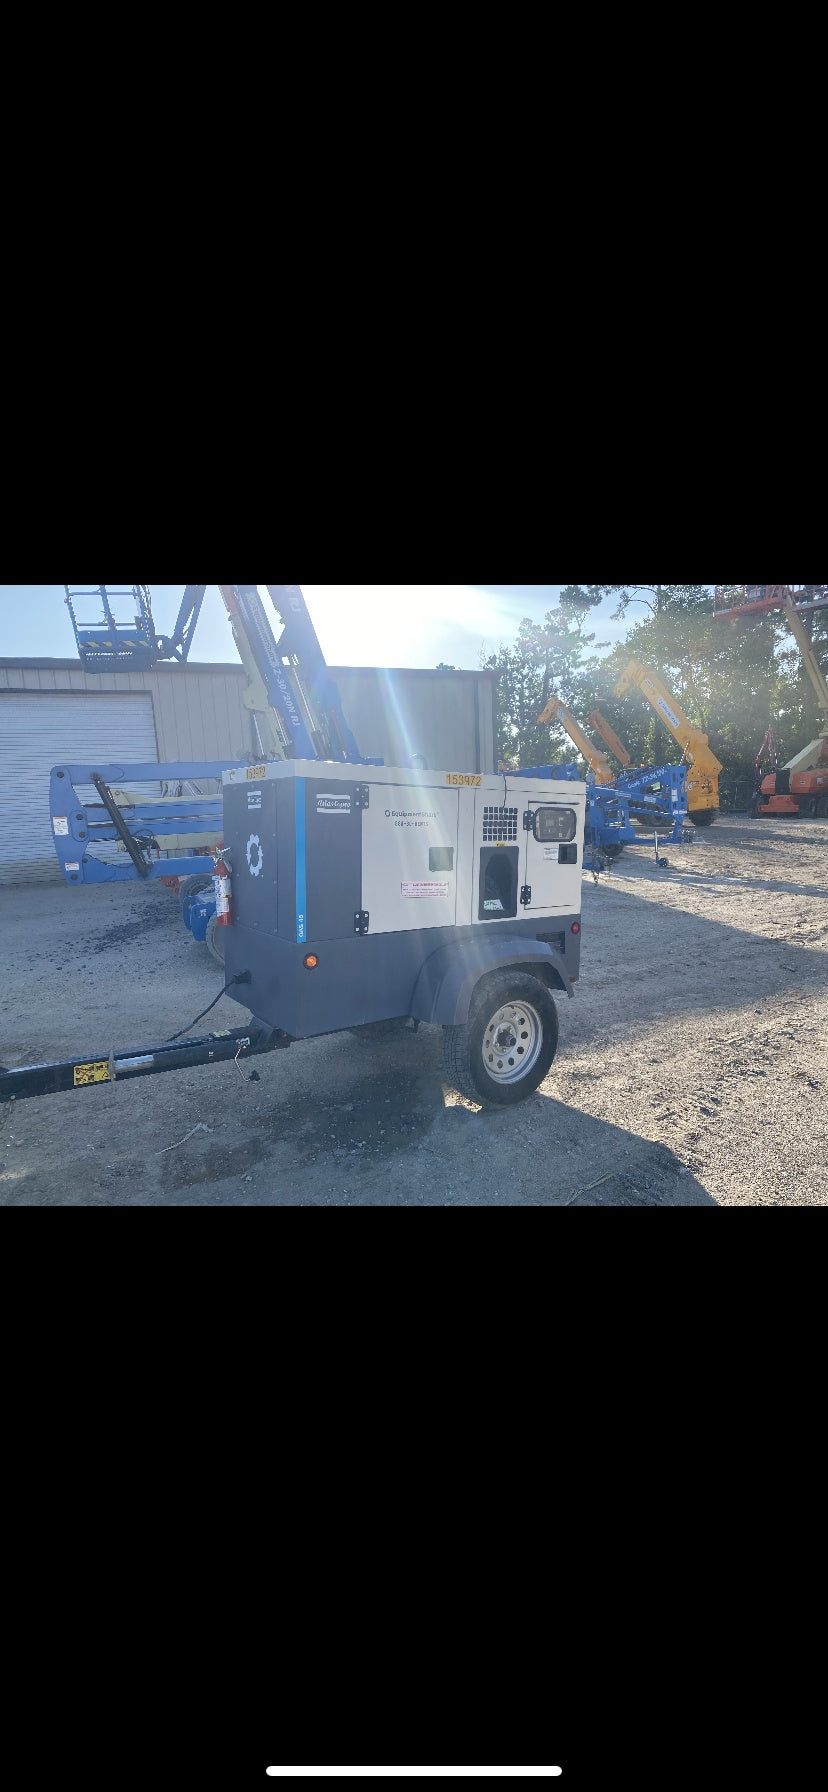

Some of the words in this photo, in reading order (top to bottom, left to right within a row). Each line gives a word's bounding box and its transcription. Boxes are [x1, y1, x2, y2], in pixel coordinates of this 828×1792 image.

[273, 668, 296, 714] Z-30/20N
[290, 715, 301, 726] RJ
[447, 774, 482, 786] 153972
